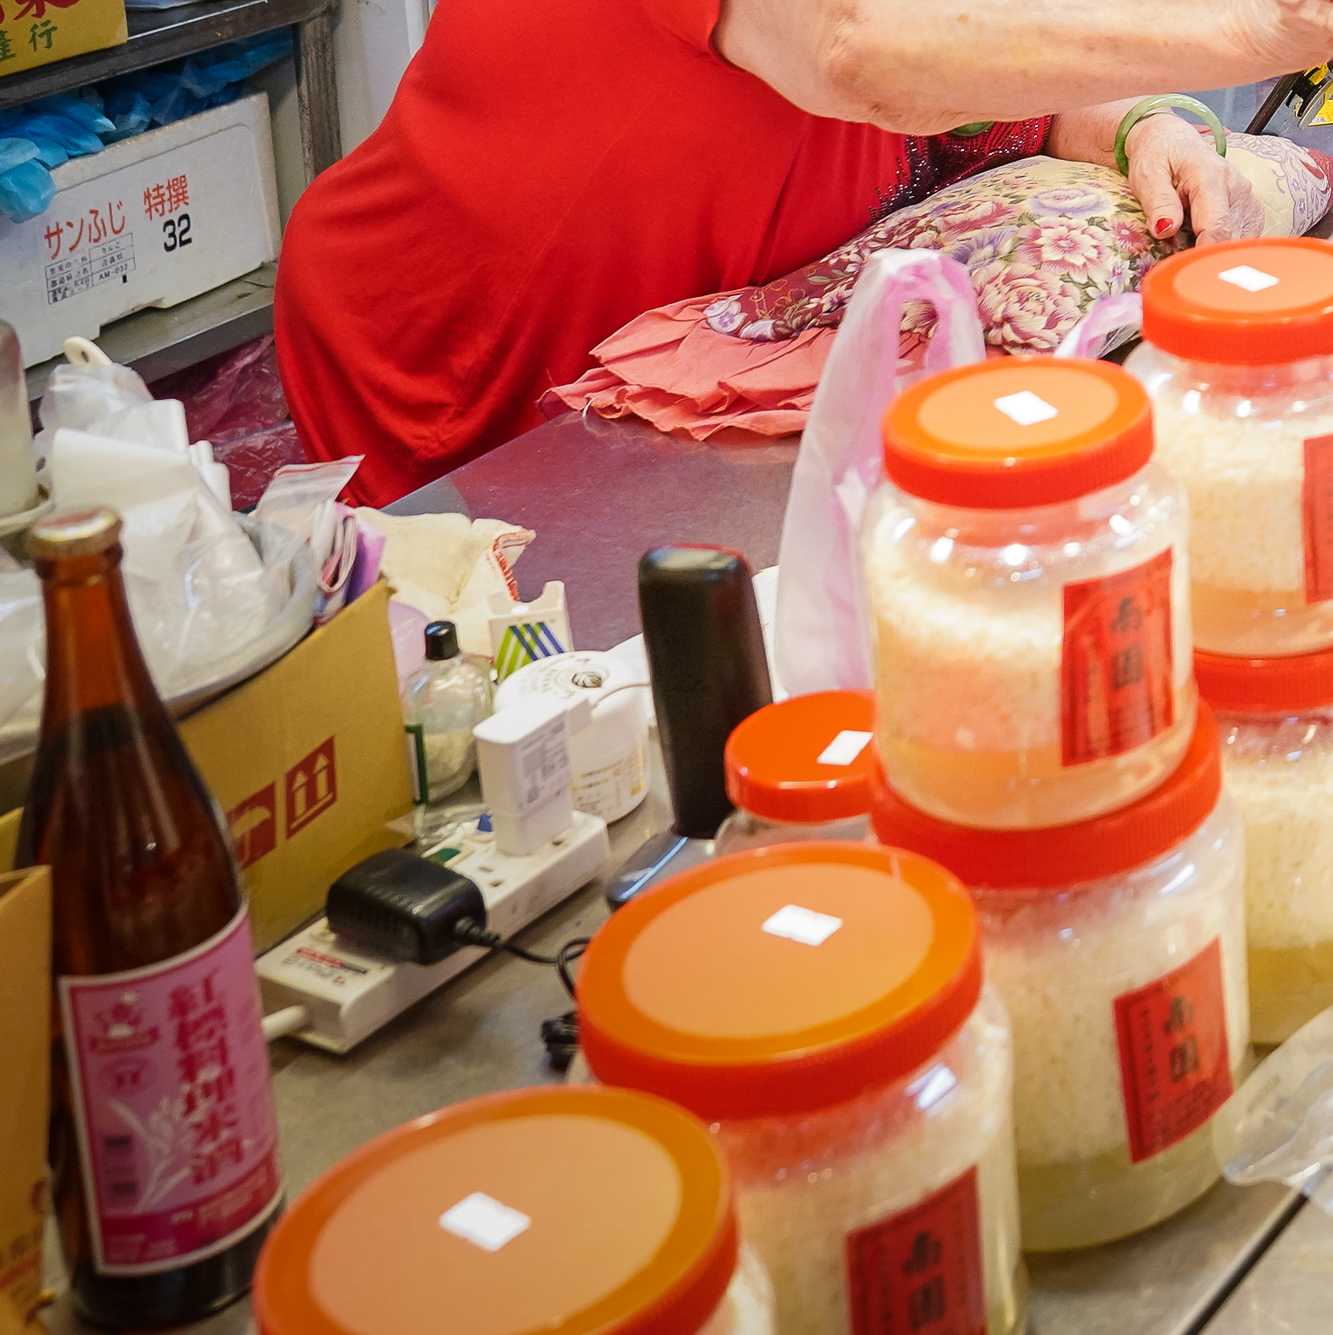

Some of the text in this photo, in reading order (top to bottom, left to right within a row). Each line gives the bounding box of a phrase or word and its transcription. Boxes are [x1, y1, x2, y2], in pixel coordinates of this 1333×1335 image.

[43, 200, 126, 261] サンふじ
[143, 173, 190, 221] 特撰
[162, 213, 193, 254] 32
